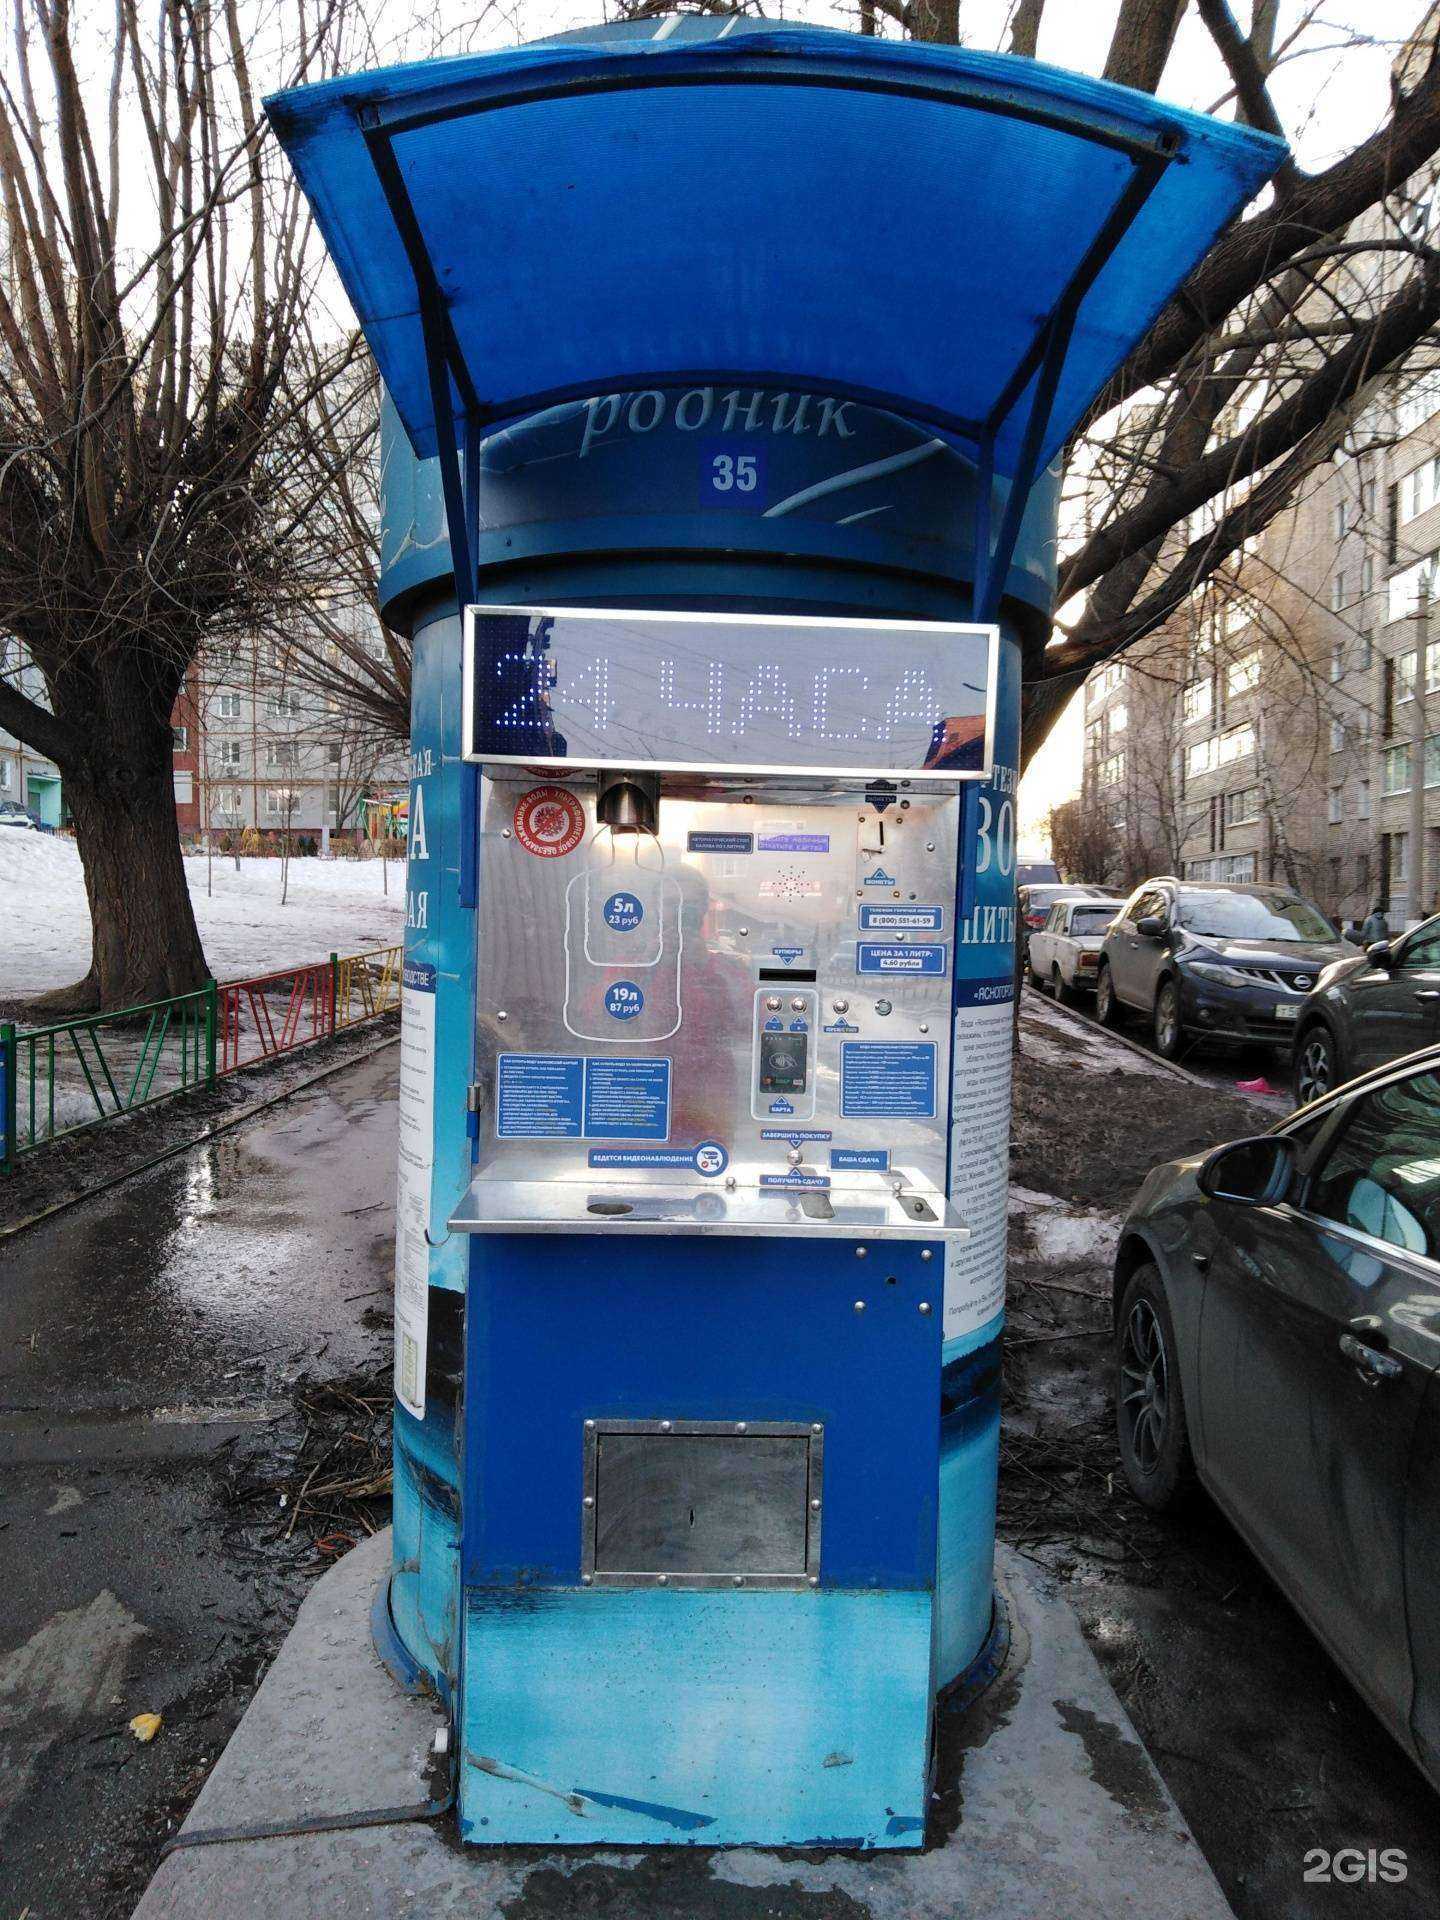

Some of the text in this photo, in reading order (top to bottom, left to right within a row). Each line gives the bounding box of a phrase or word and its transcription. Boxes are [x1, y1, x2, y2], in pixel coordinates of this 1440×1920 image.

[712, 454, 757, 492] 35
[496, 653, 947, 742] 24 ЧАСА
[613, 898, 634, 914] 5л
[609, 915, 639, 926] 23 руб
[879, 917, 898, 925] (800)
[613, 988, 638, 1002] 19л
[610, 1003, 640, 1013] 87 руб
[762, 1131, 831, 1140] ЗАВЕРШИТЬ ПОКУПКУ
[767, 1177, 825, 1186] ПОЛУЧИТЬ СДАЧУ
